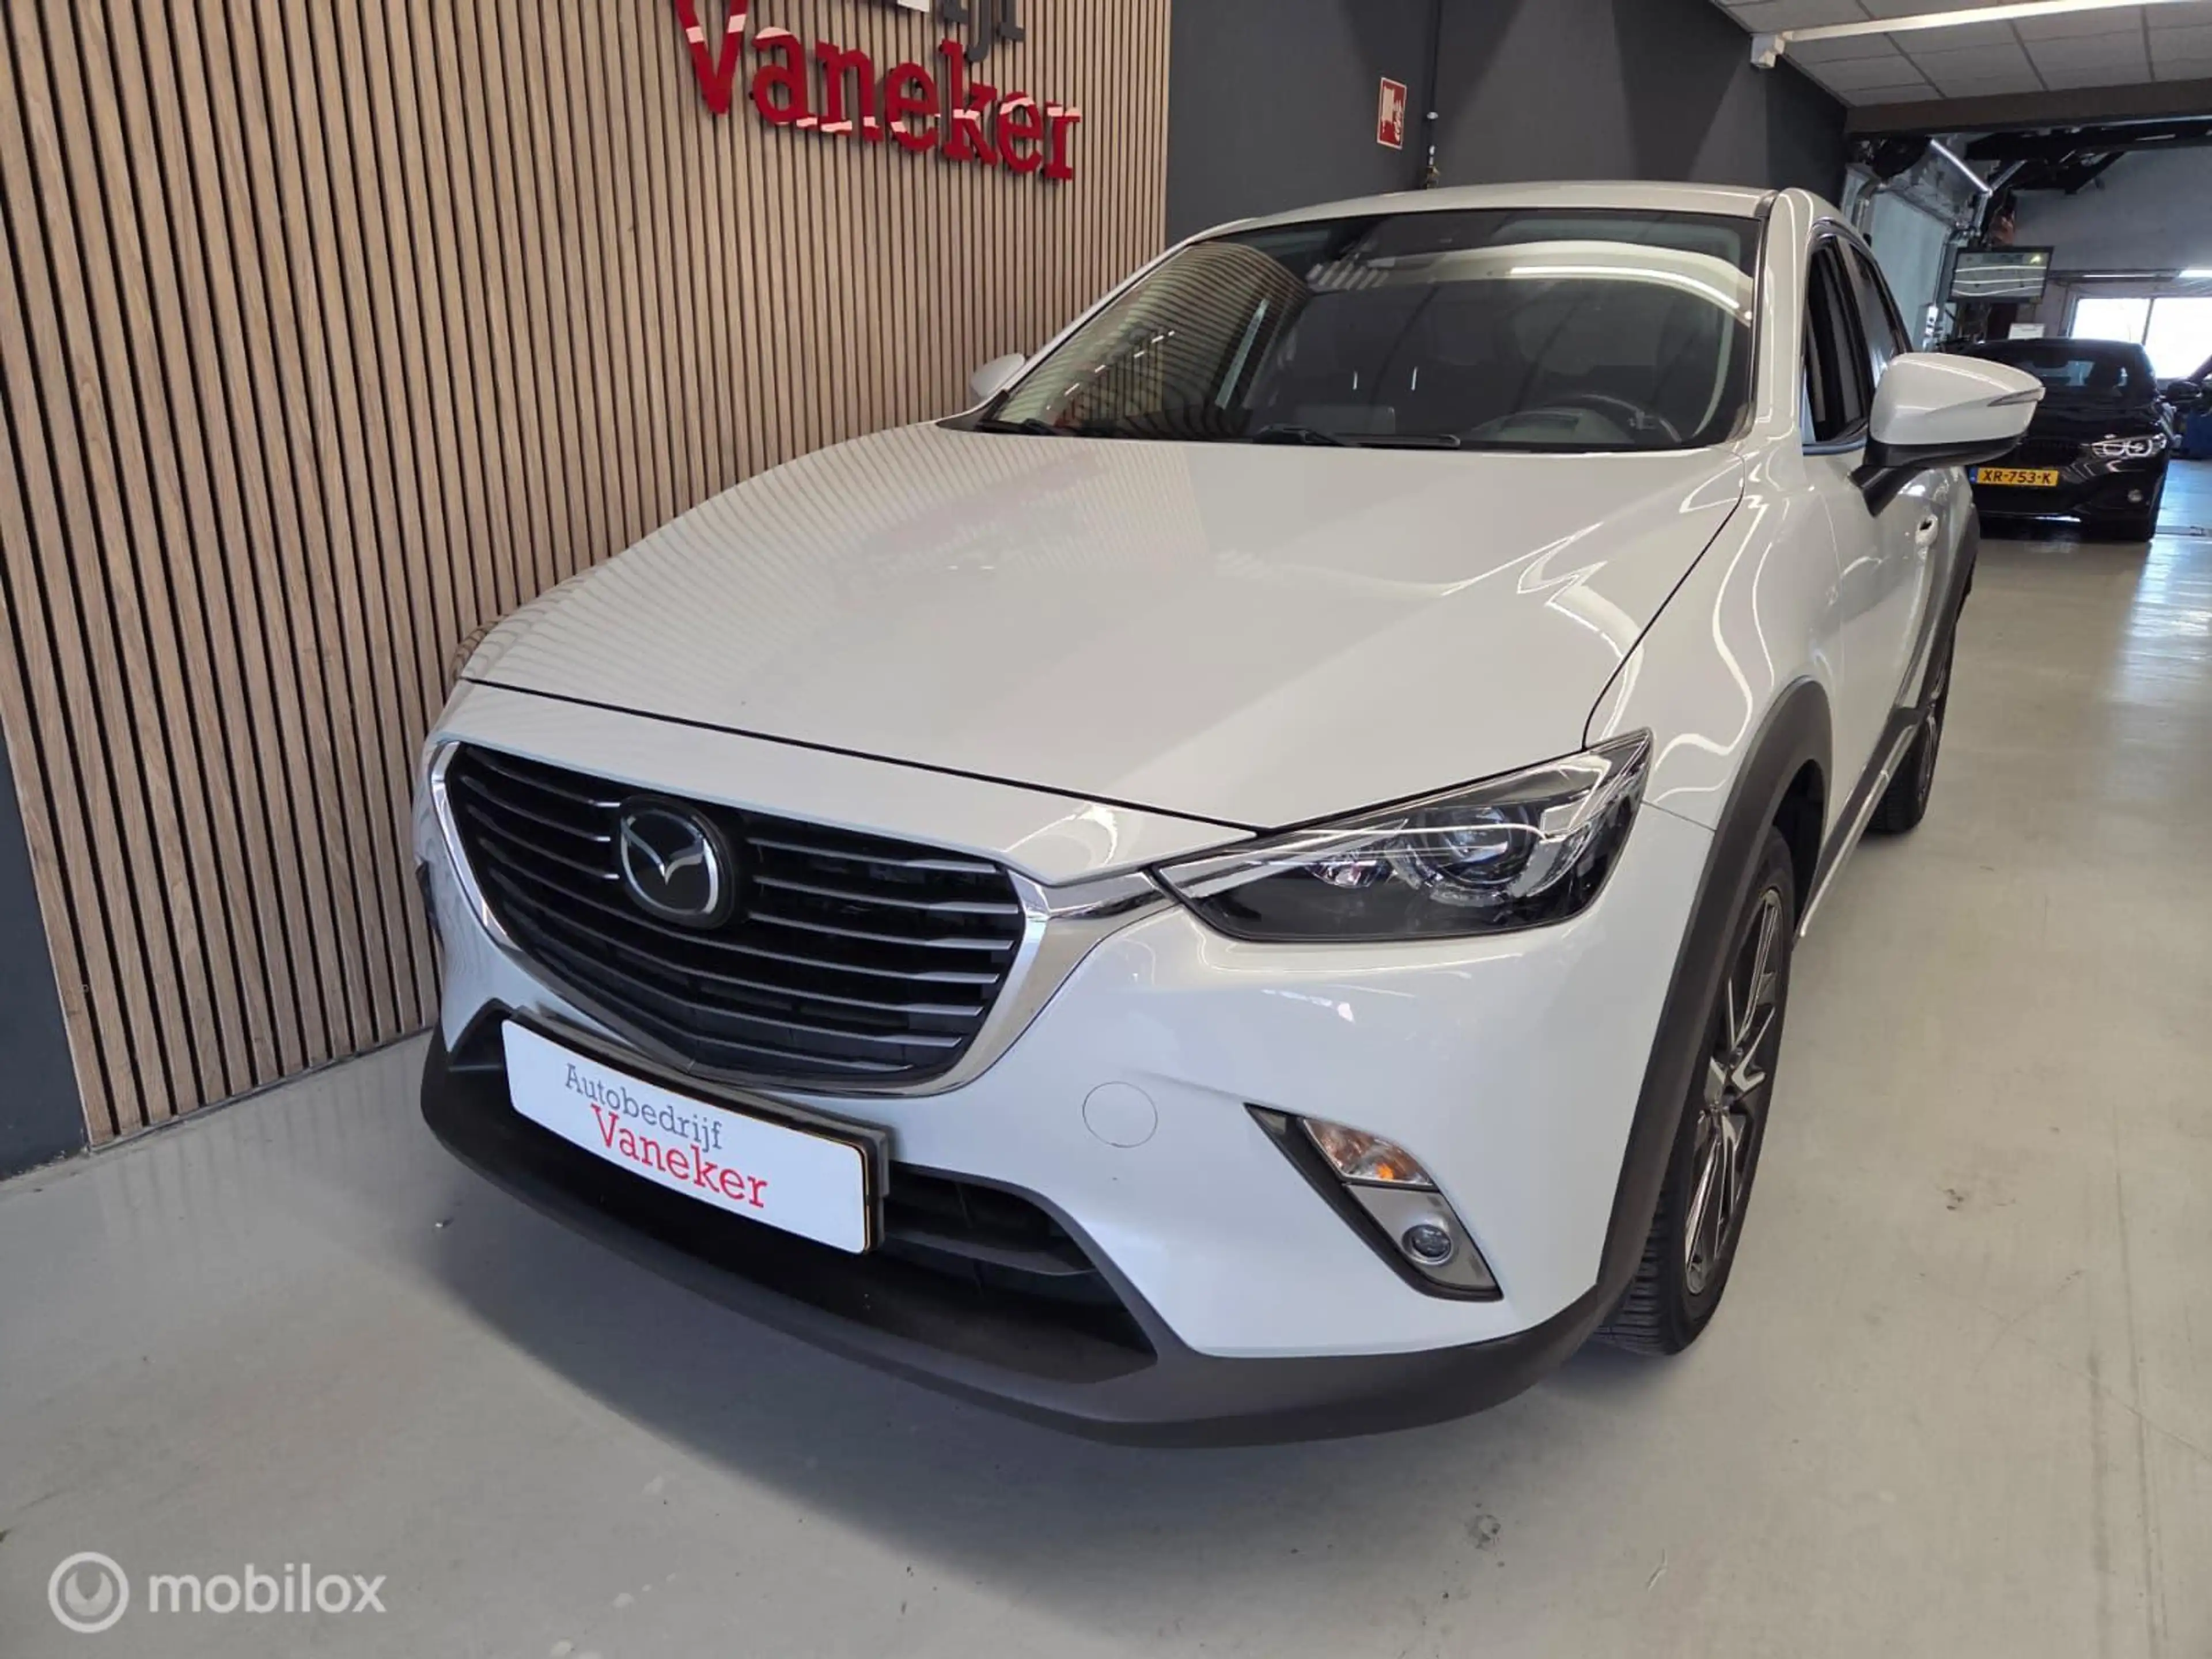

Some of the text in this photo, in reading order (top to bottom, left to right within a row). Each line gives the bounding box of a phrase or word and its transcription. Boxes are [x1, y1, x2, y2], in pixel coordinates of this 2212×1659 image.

[675, 0, 1081, 181] Vaneker
[1982, 469, 2052, 484] XR-753-K
[565, 1063, 723, 1152] Autobedrijf
[592, 1103, 768, 1209] Vaneker
